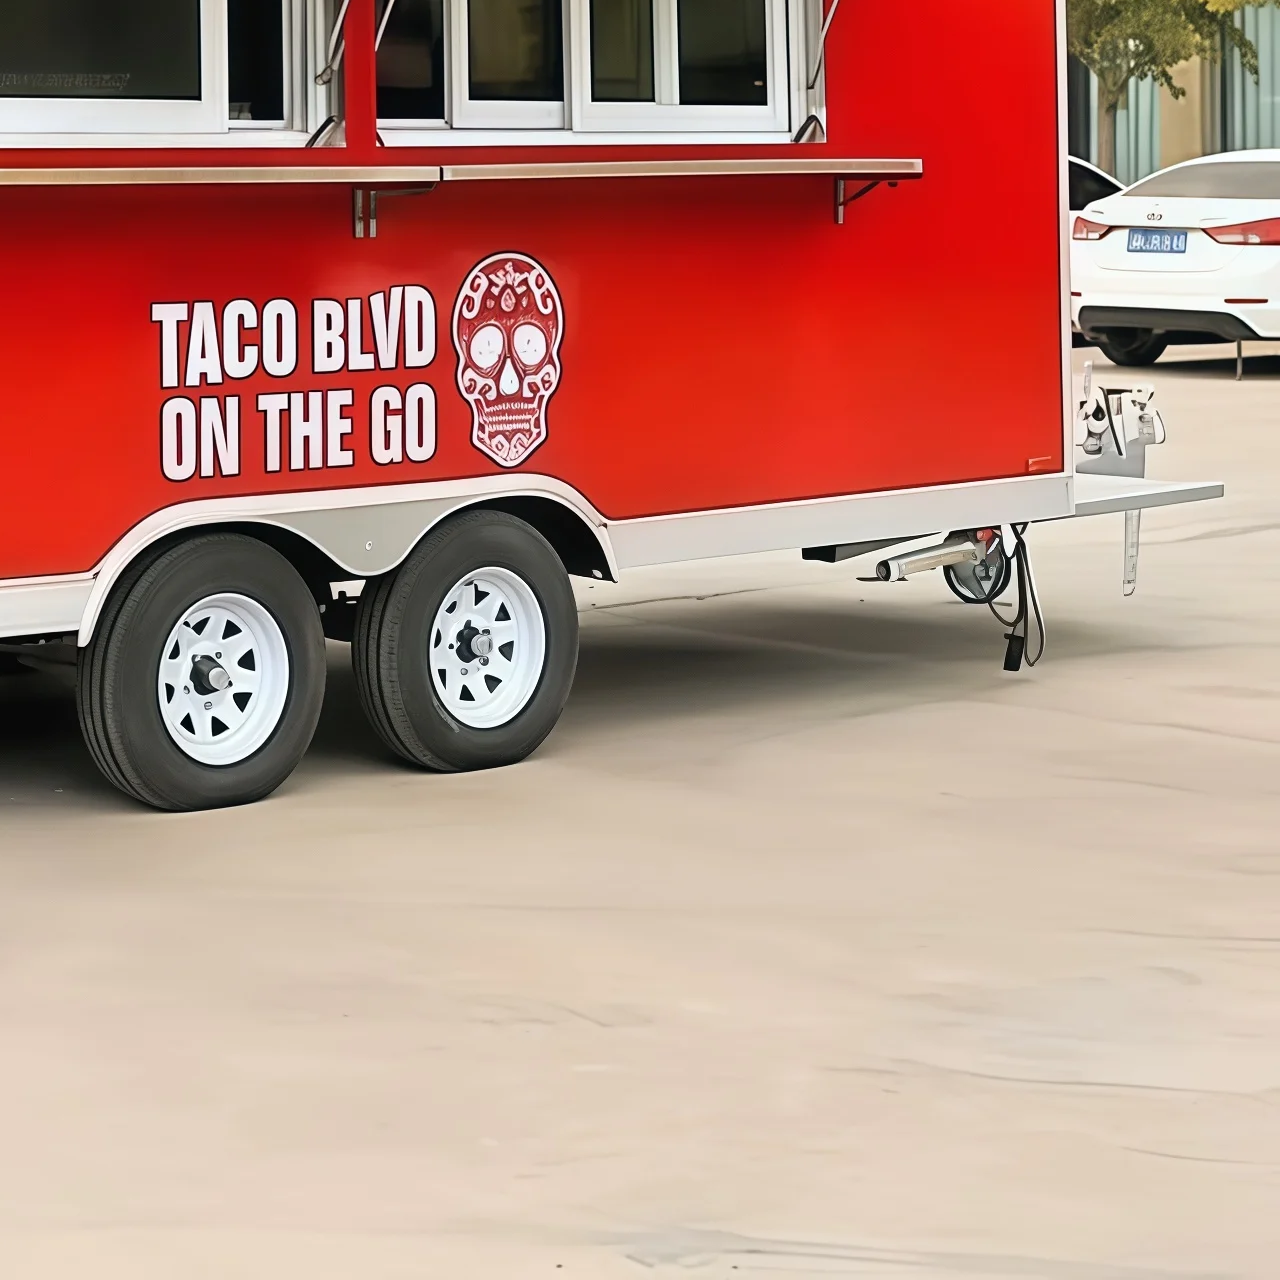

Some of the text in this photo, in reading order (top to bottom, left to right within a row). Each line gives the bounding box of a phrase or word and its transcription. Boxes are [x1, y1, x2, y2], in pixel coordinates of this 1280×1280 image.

[151, 284, 437, 388] TACO BLVD
[160, 383, 437, 482] ON THE GO
